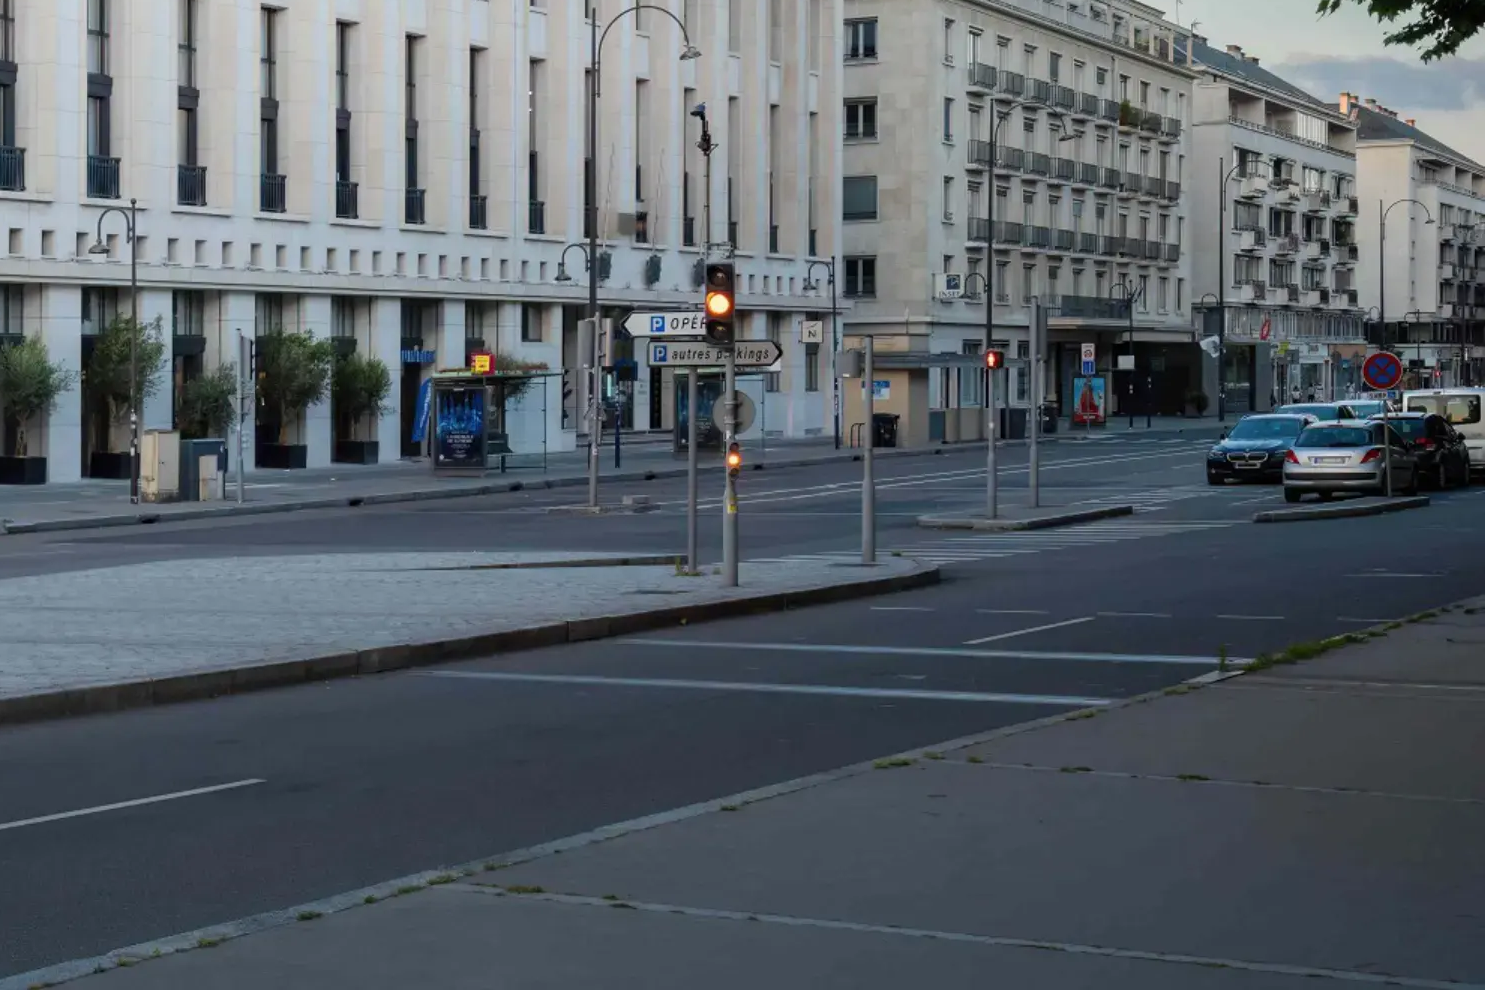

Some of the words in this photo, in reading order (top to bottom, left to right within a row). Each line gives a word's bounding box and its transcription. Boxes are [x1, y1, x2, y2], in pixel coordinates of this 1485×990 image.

[652, 317, 663, 331] P
[670, 314, 707, 330] OPÉR
[655, 347, 665, 361] P
[671, 348, 711, 360] autres
[715, 346, 769, 362] pkings
